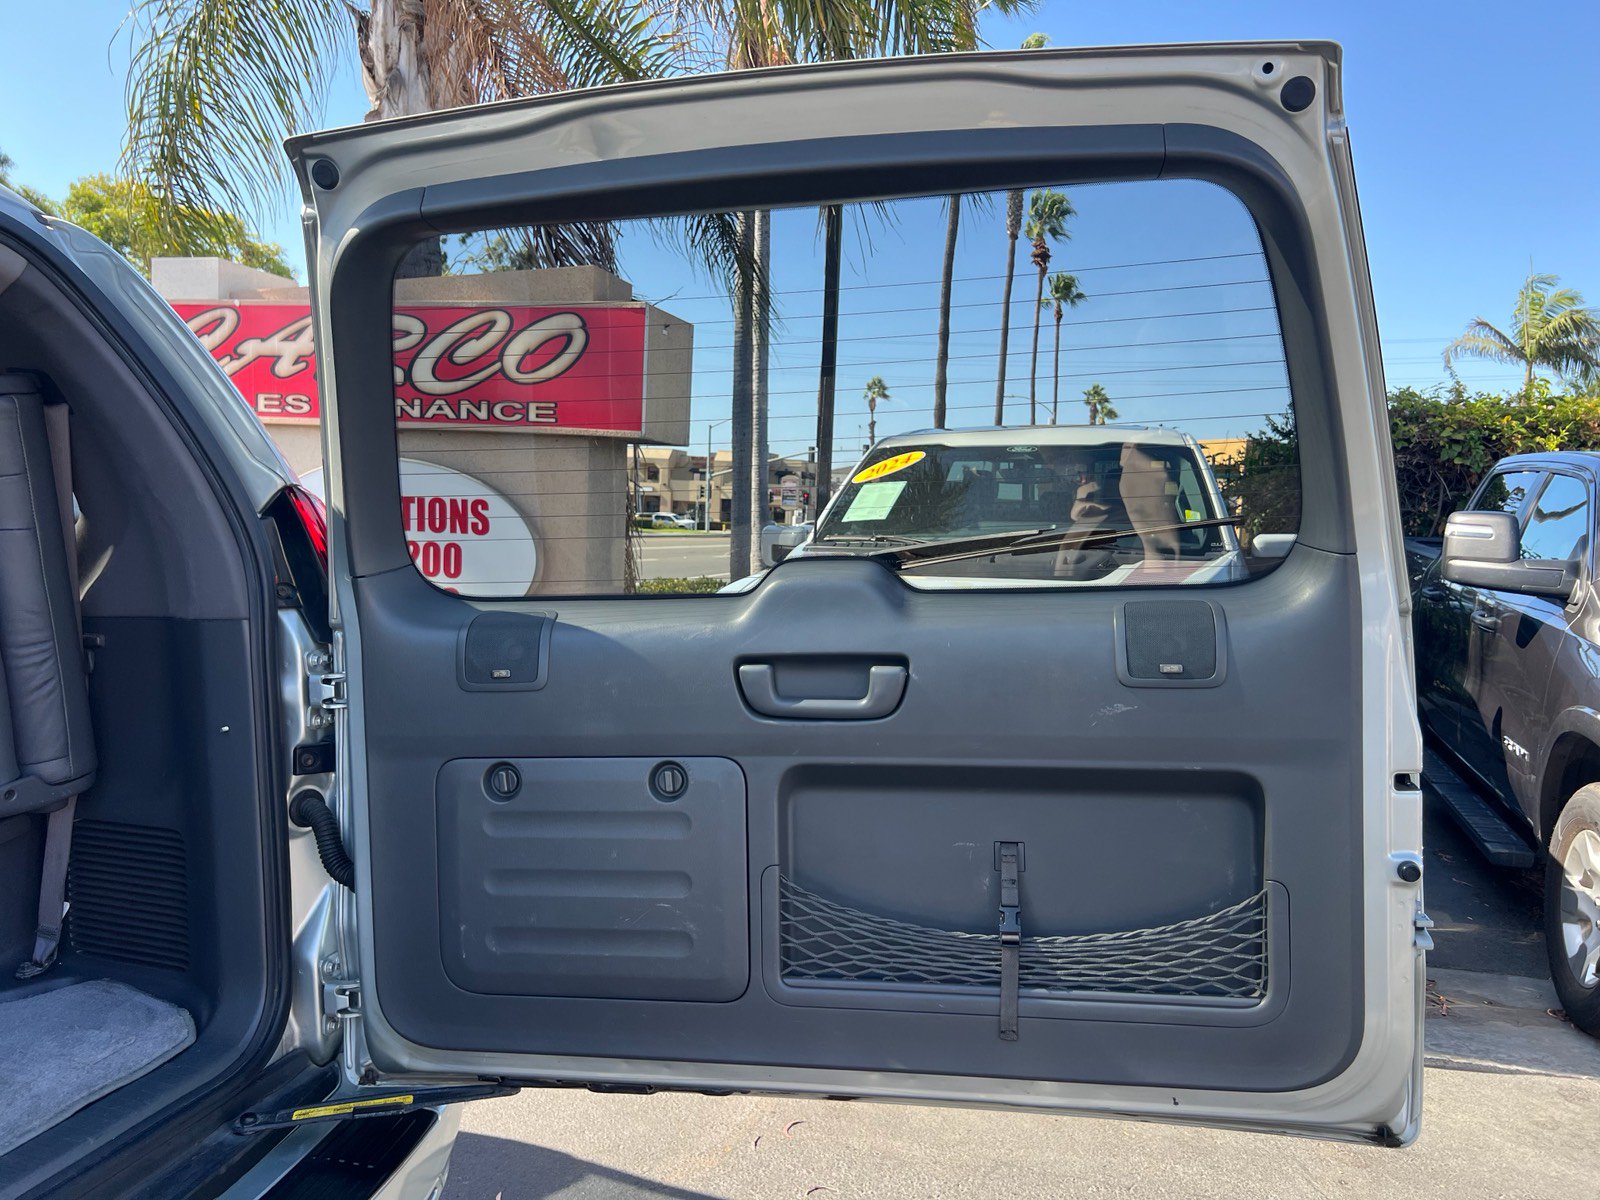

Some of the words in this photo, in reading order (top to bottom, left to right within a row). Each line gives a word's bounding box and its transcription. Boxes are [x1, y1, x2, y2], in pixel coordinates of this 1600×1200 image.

[396, 398, 558, 423] NANCE
[865, 453, 916, 478] 2024
[401, 496, 490, 536] TIONS
